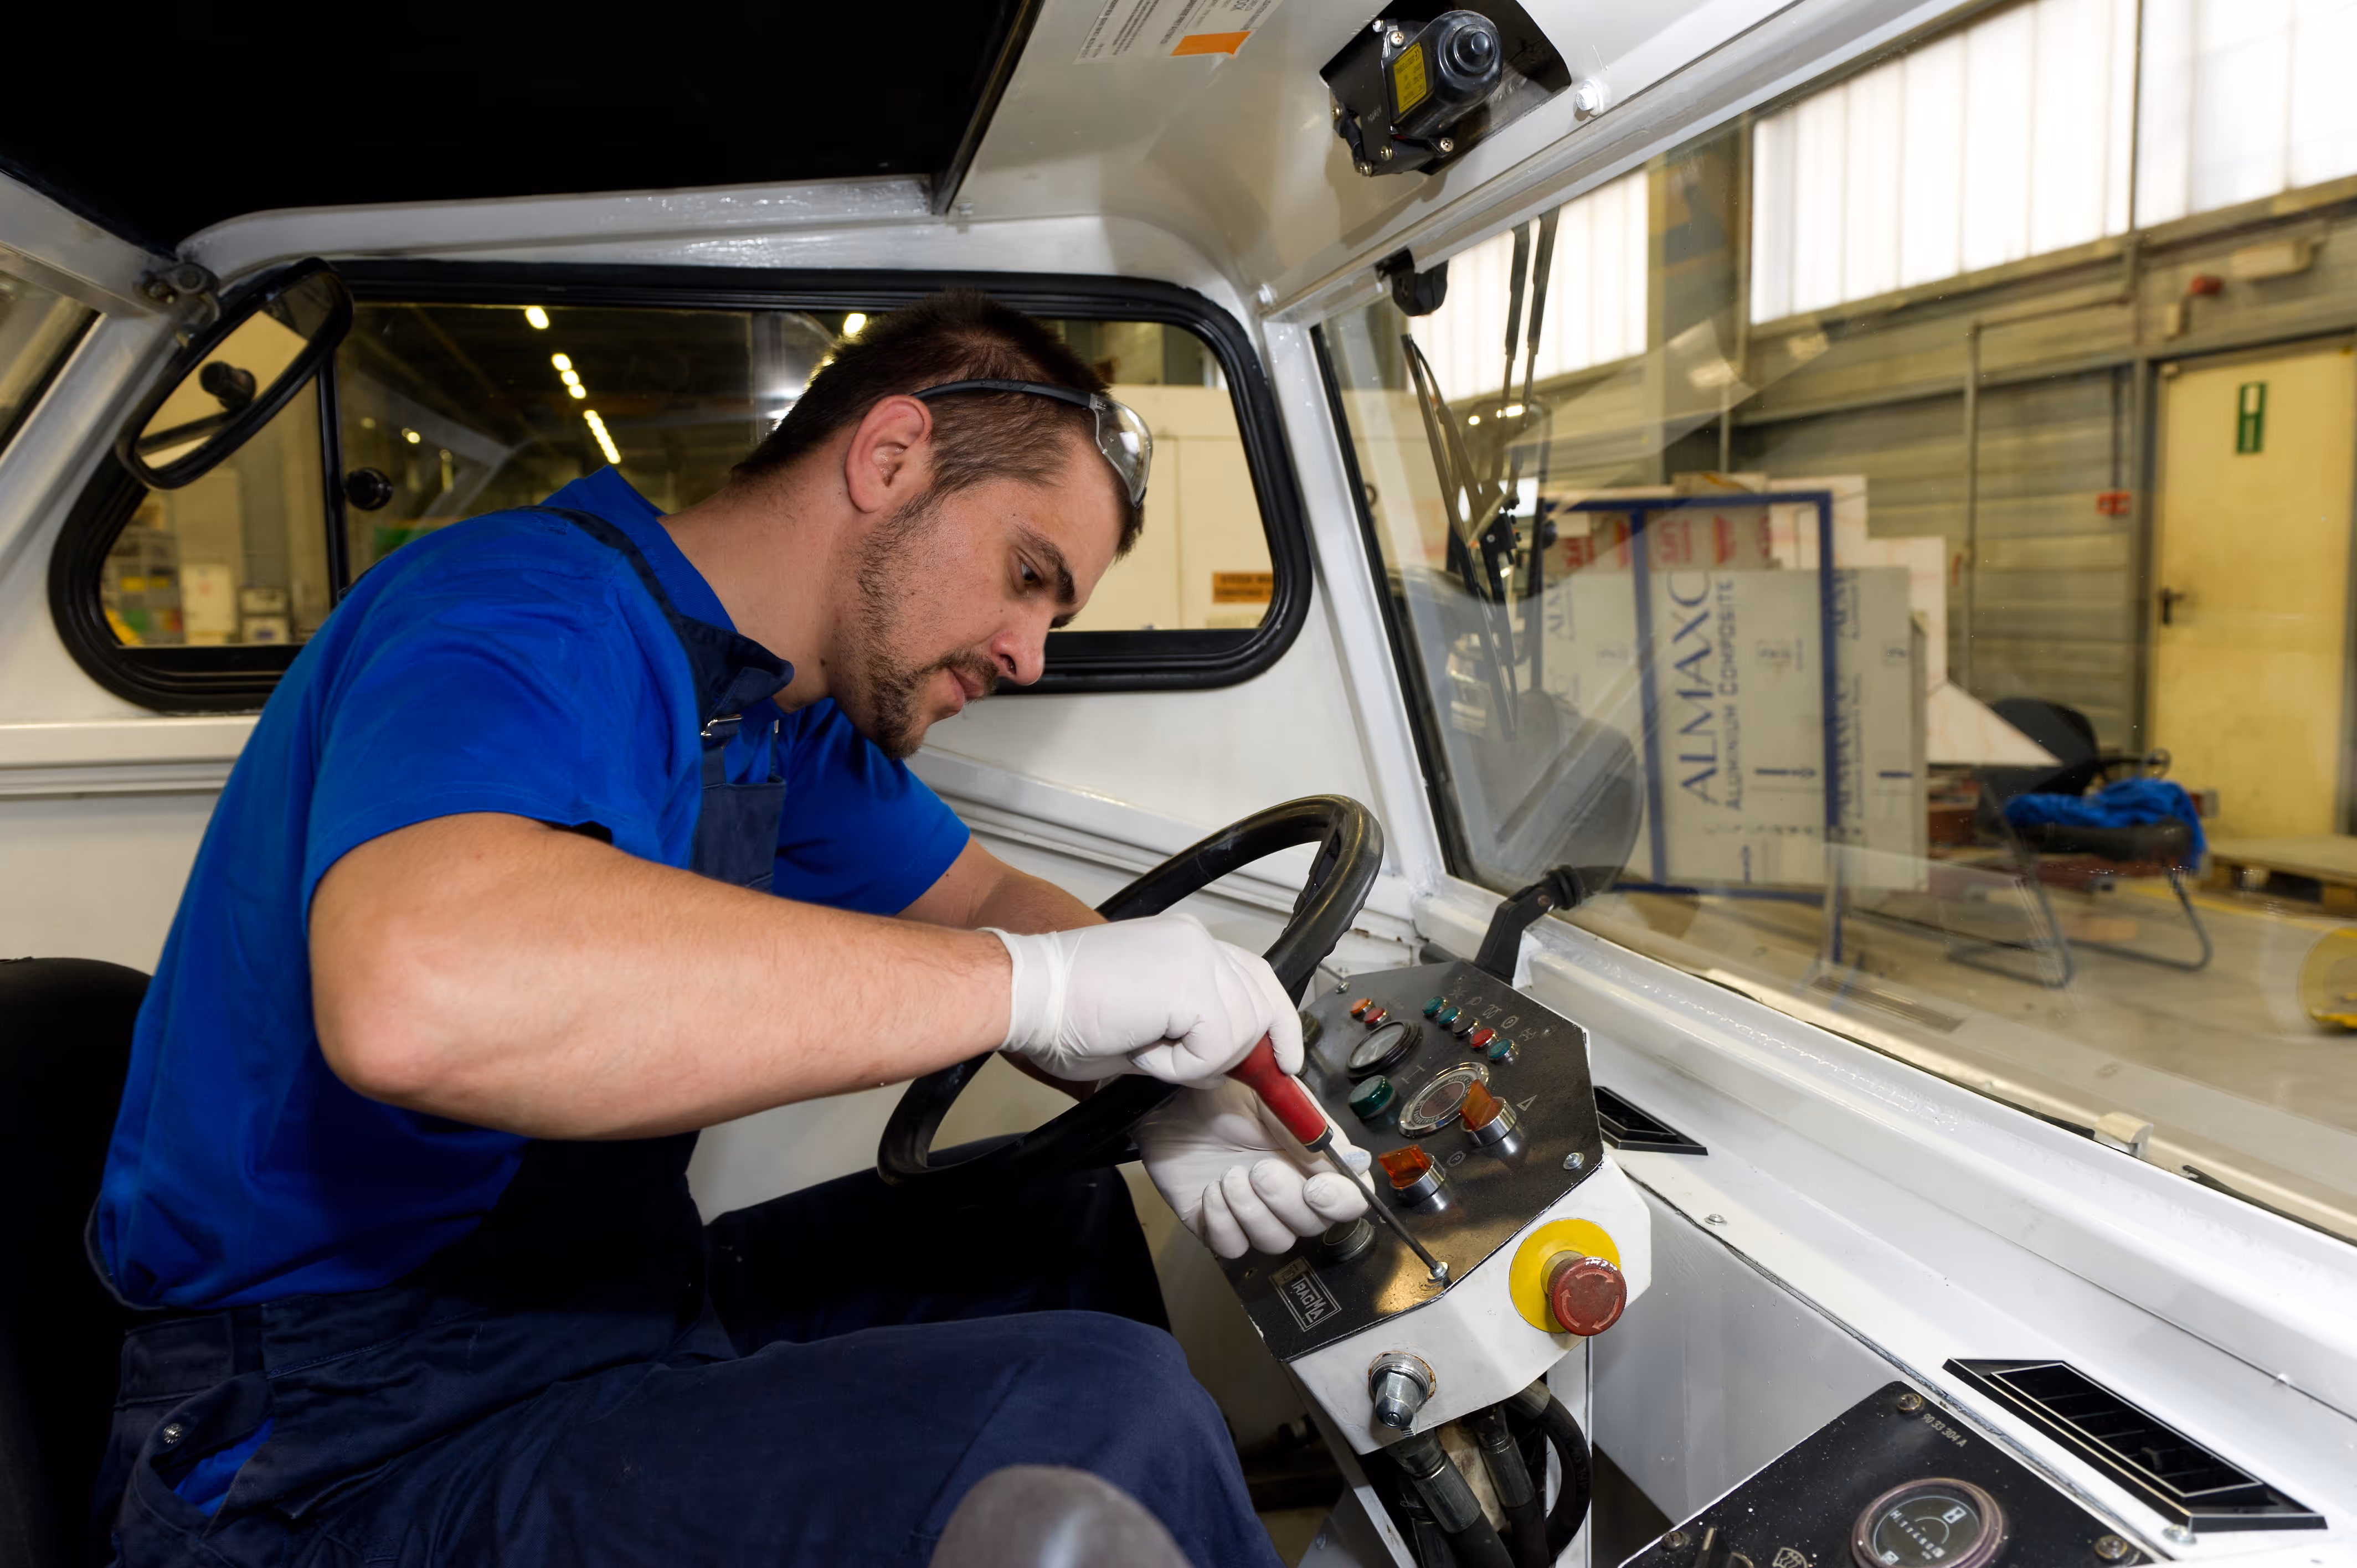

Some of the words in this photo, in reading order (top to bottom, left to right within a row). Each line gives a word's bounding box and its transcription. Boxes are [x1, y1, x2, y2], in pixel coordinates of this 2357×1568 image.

[1718, 579, 1738, 696] COMPOSITE
[1922, 1413, 1936, 1423] 90
[1931, 1420, 1946, 1431] 33
[1941, 1427, 1962, 1442] 304
[1956, 1439, 1968, 1447] A
